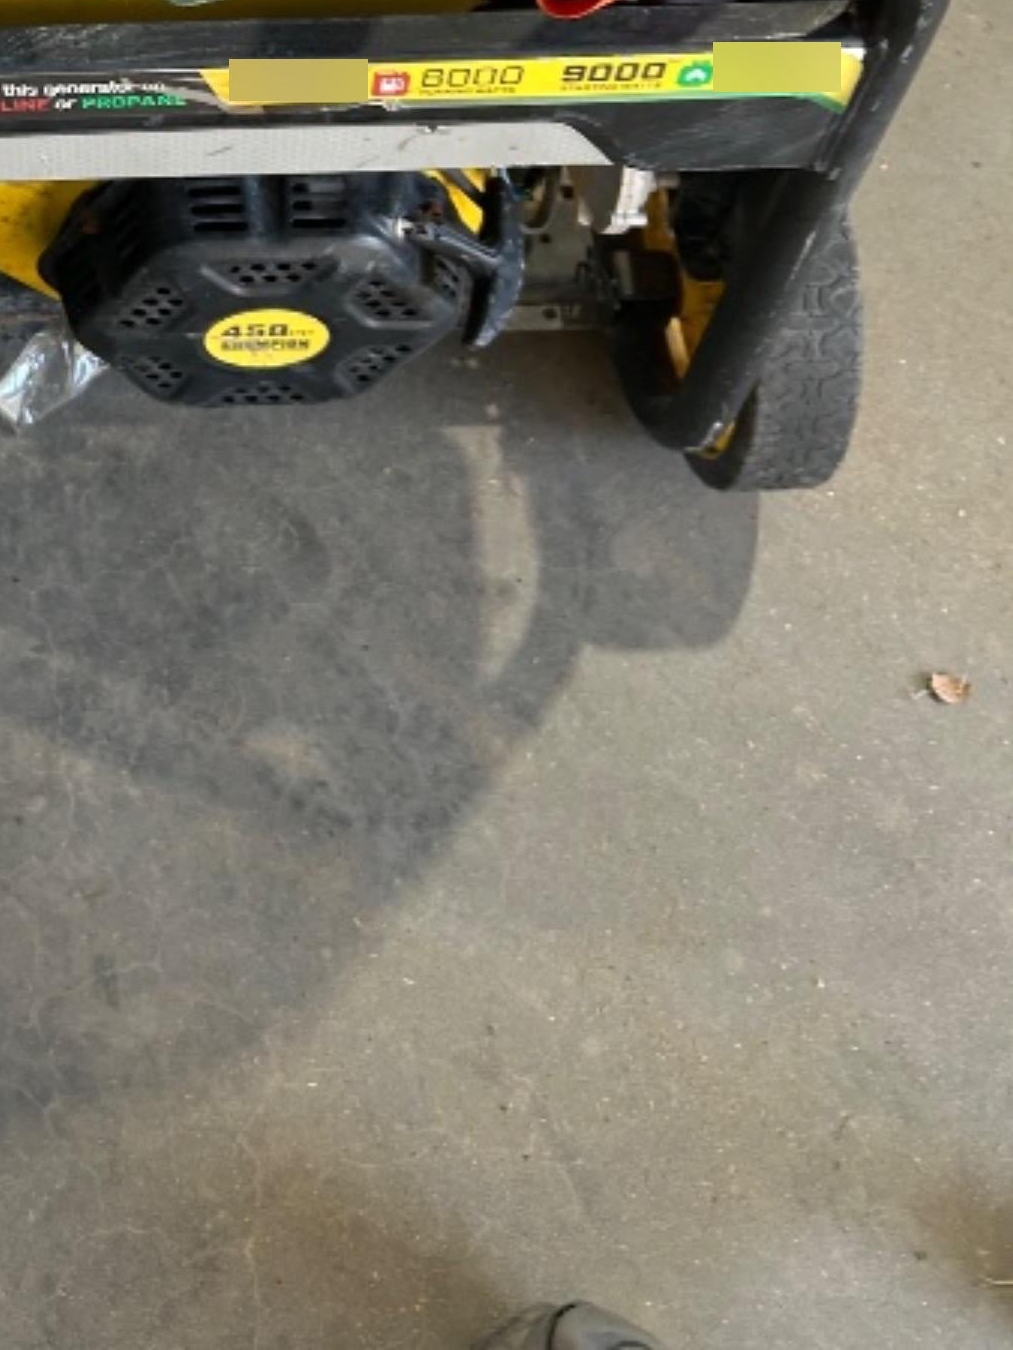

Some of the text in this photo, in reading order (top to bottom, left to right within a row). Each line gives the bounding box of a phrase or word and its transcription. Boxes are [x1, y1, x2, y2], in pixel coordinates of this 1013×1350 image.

[561, 61, 667, 82] 9000
[1, 82, 38, 97] this
[55, 98, 78, 112] or
